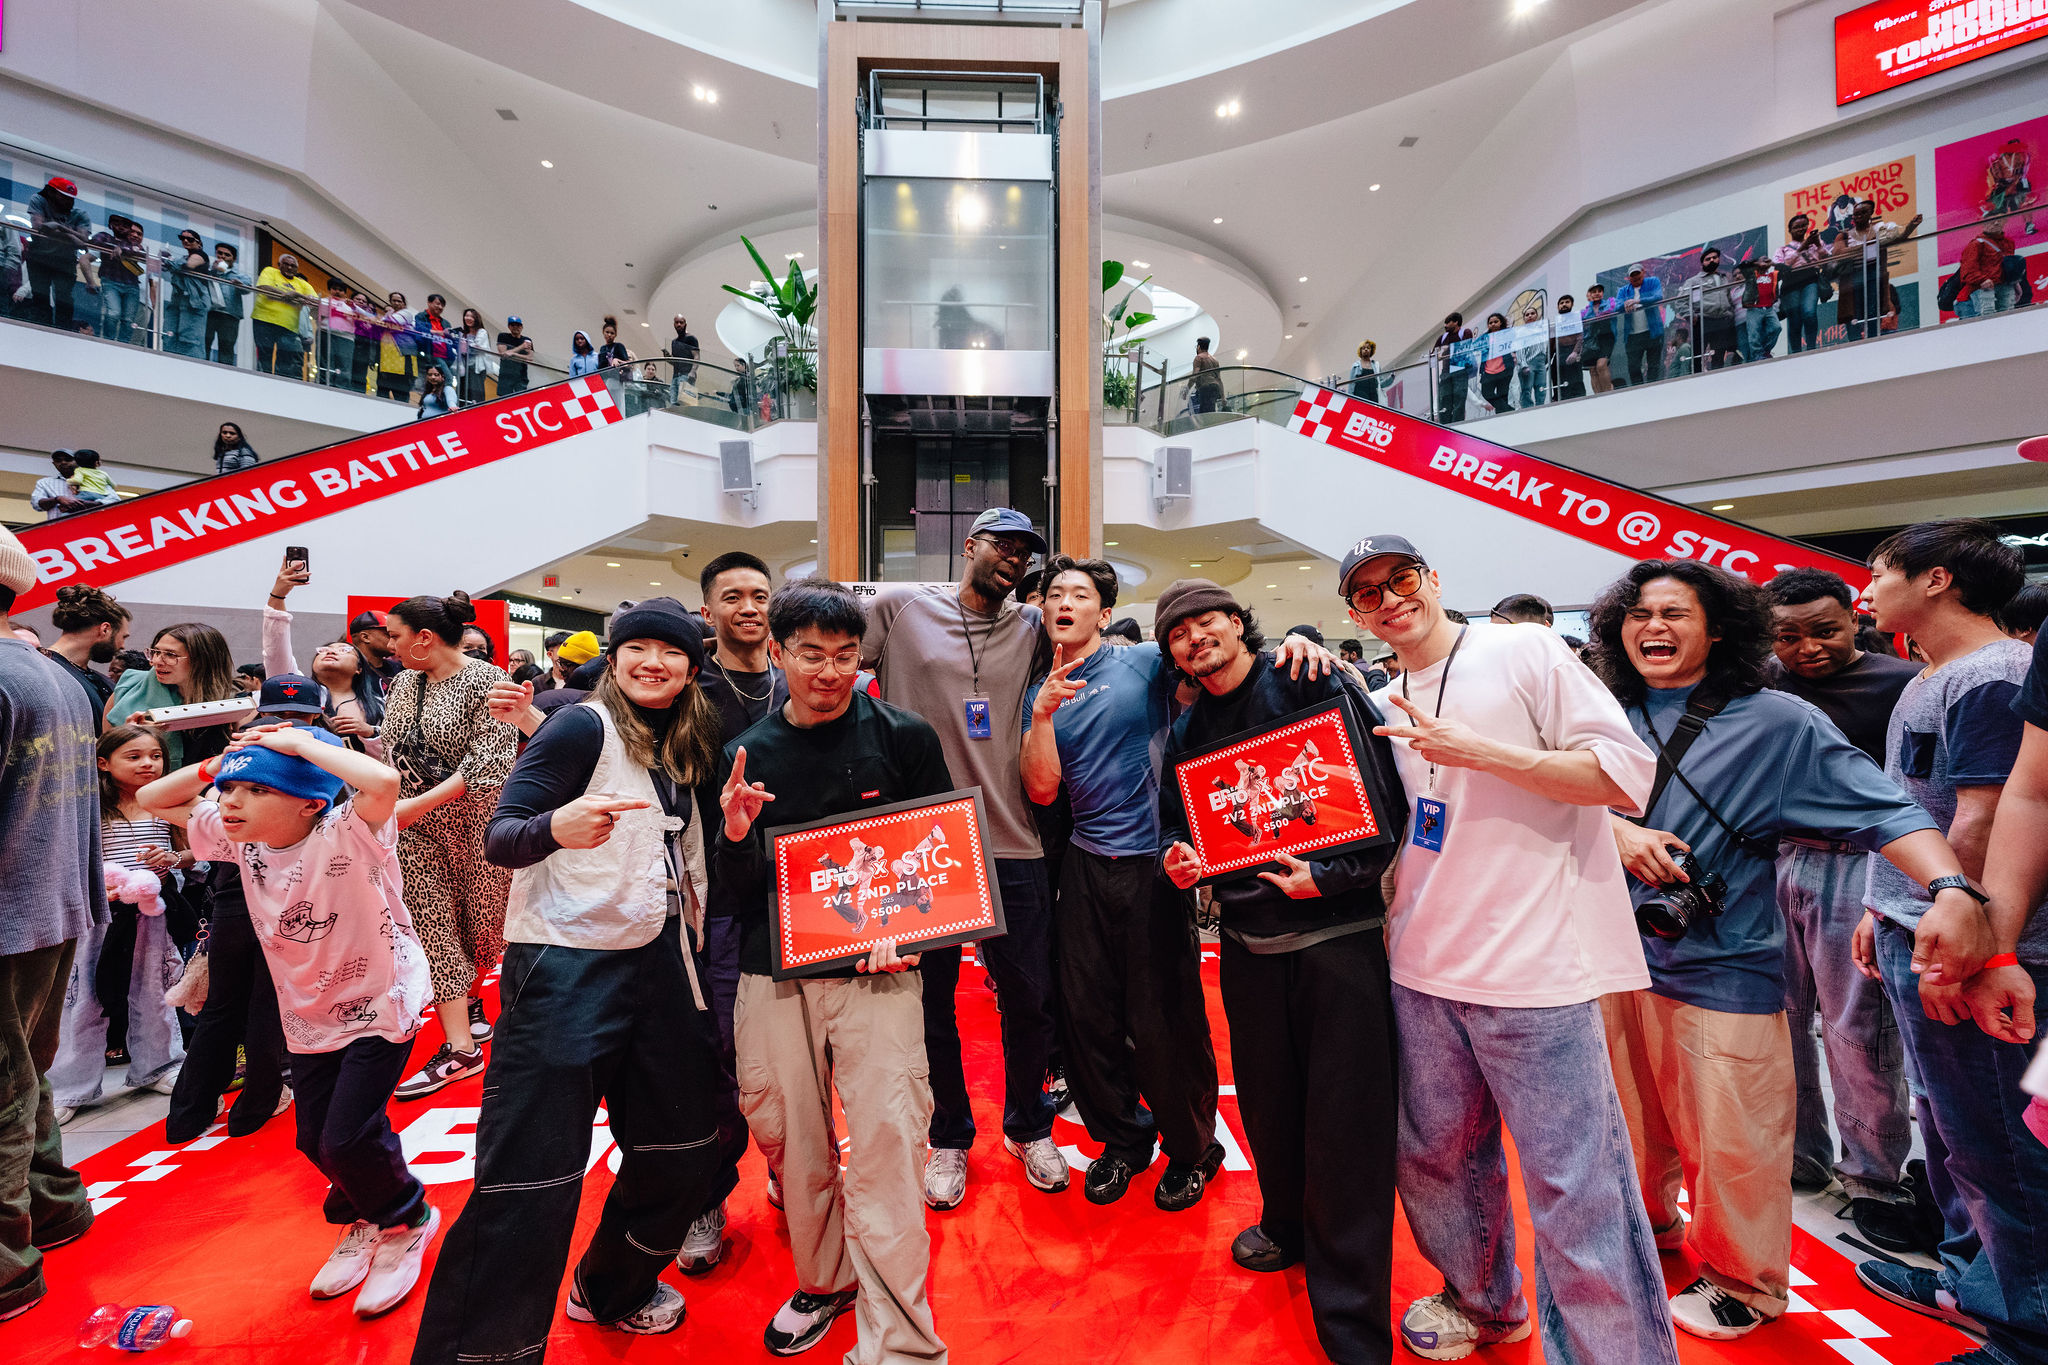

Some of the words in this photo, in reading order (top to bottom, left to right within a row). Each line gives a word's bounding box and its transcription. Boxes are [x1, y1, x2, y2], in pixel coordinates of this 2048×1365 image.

[1792, 183, 1833, 209] THE
[1840, 162, 1904, 195] WORLD
[34, 479, 308, 585] BREAKING
[309, 431, 470, 498] BATTLE
[495, 401, 563, 444] STC
[1428, 444, 1555, 508] BREAK
[1557, 488, 1611, 526] TO
[1617, 511, 1661, 546] @
[1664, 530, 1760, 579] STC
[544, 576, 557, 587] EXIT
[970, 703, 985, 712] VIP
[1058, 699, 1071, 709] ed
[1070, 692, 1086, 704] Bull
[1281, 756, 1329, 790] STC
[1222, 809, 1247, 825] 2V2
[1249, 801, 1278, 817] 2ND
[1281, 785, 1329, 808] PLACE
[1422, 801, 1441, 815] VIP
[1263, 818, 1289, 832] $500
[901, 843, 953, 876] STC
[822, 892, 853, 909] 2V2
[857, 885, 891, 901] 2ND
[896, 872, 949, 894] PLACE
[880, 896, 895, 905] 2025
[870, 904, 901, 919] $500
